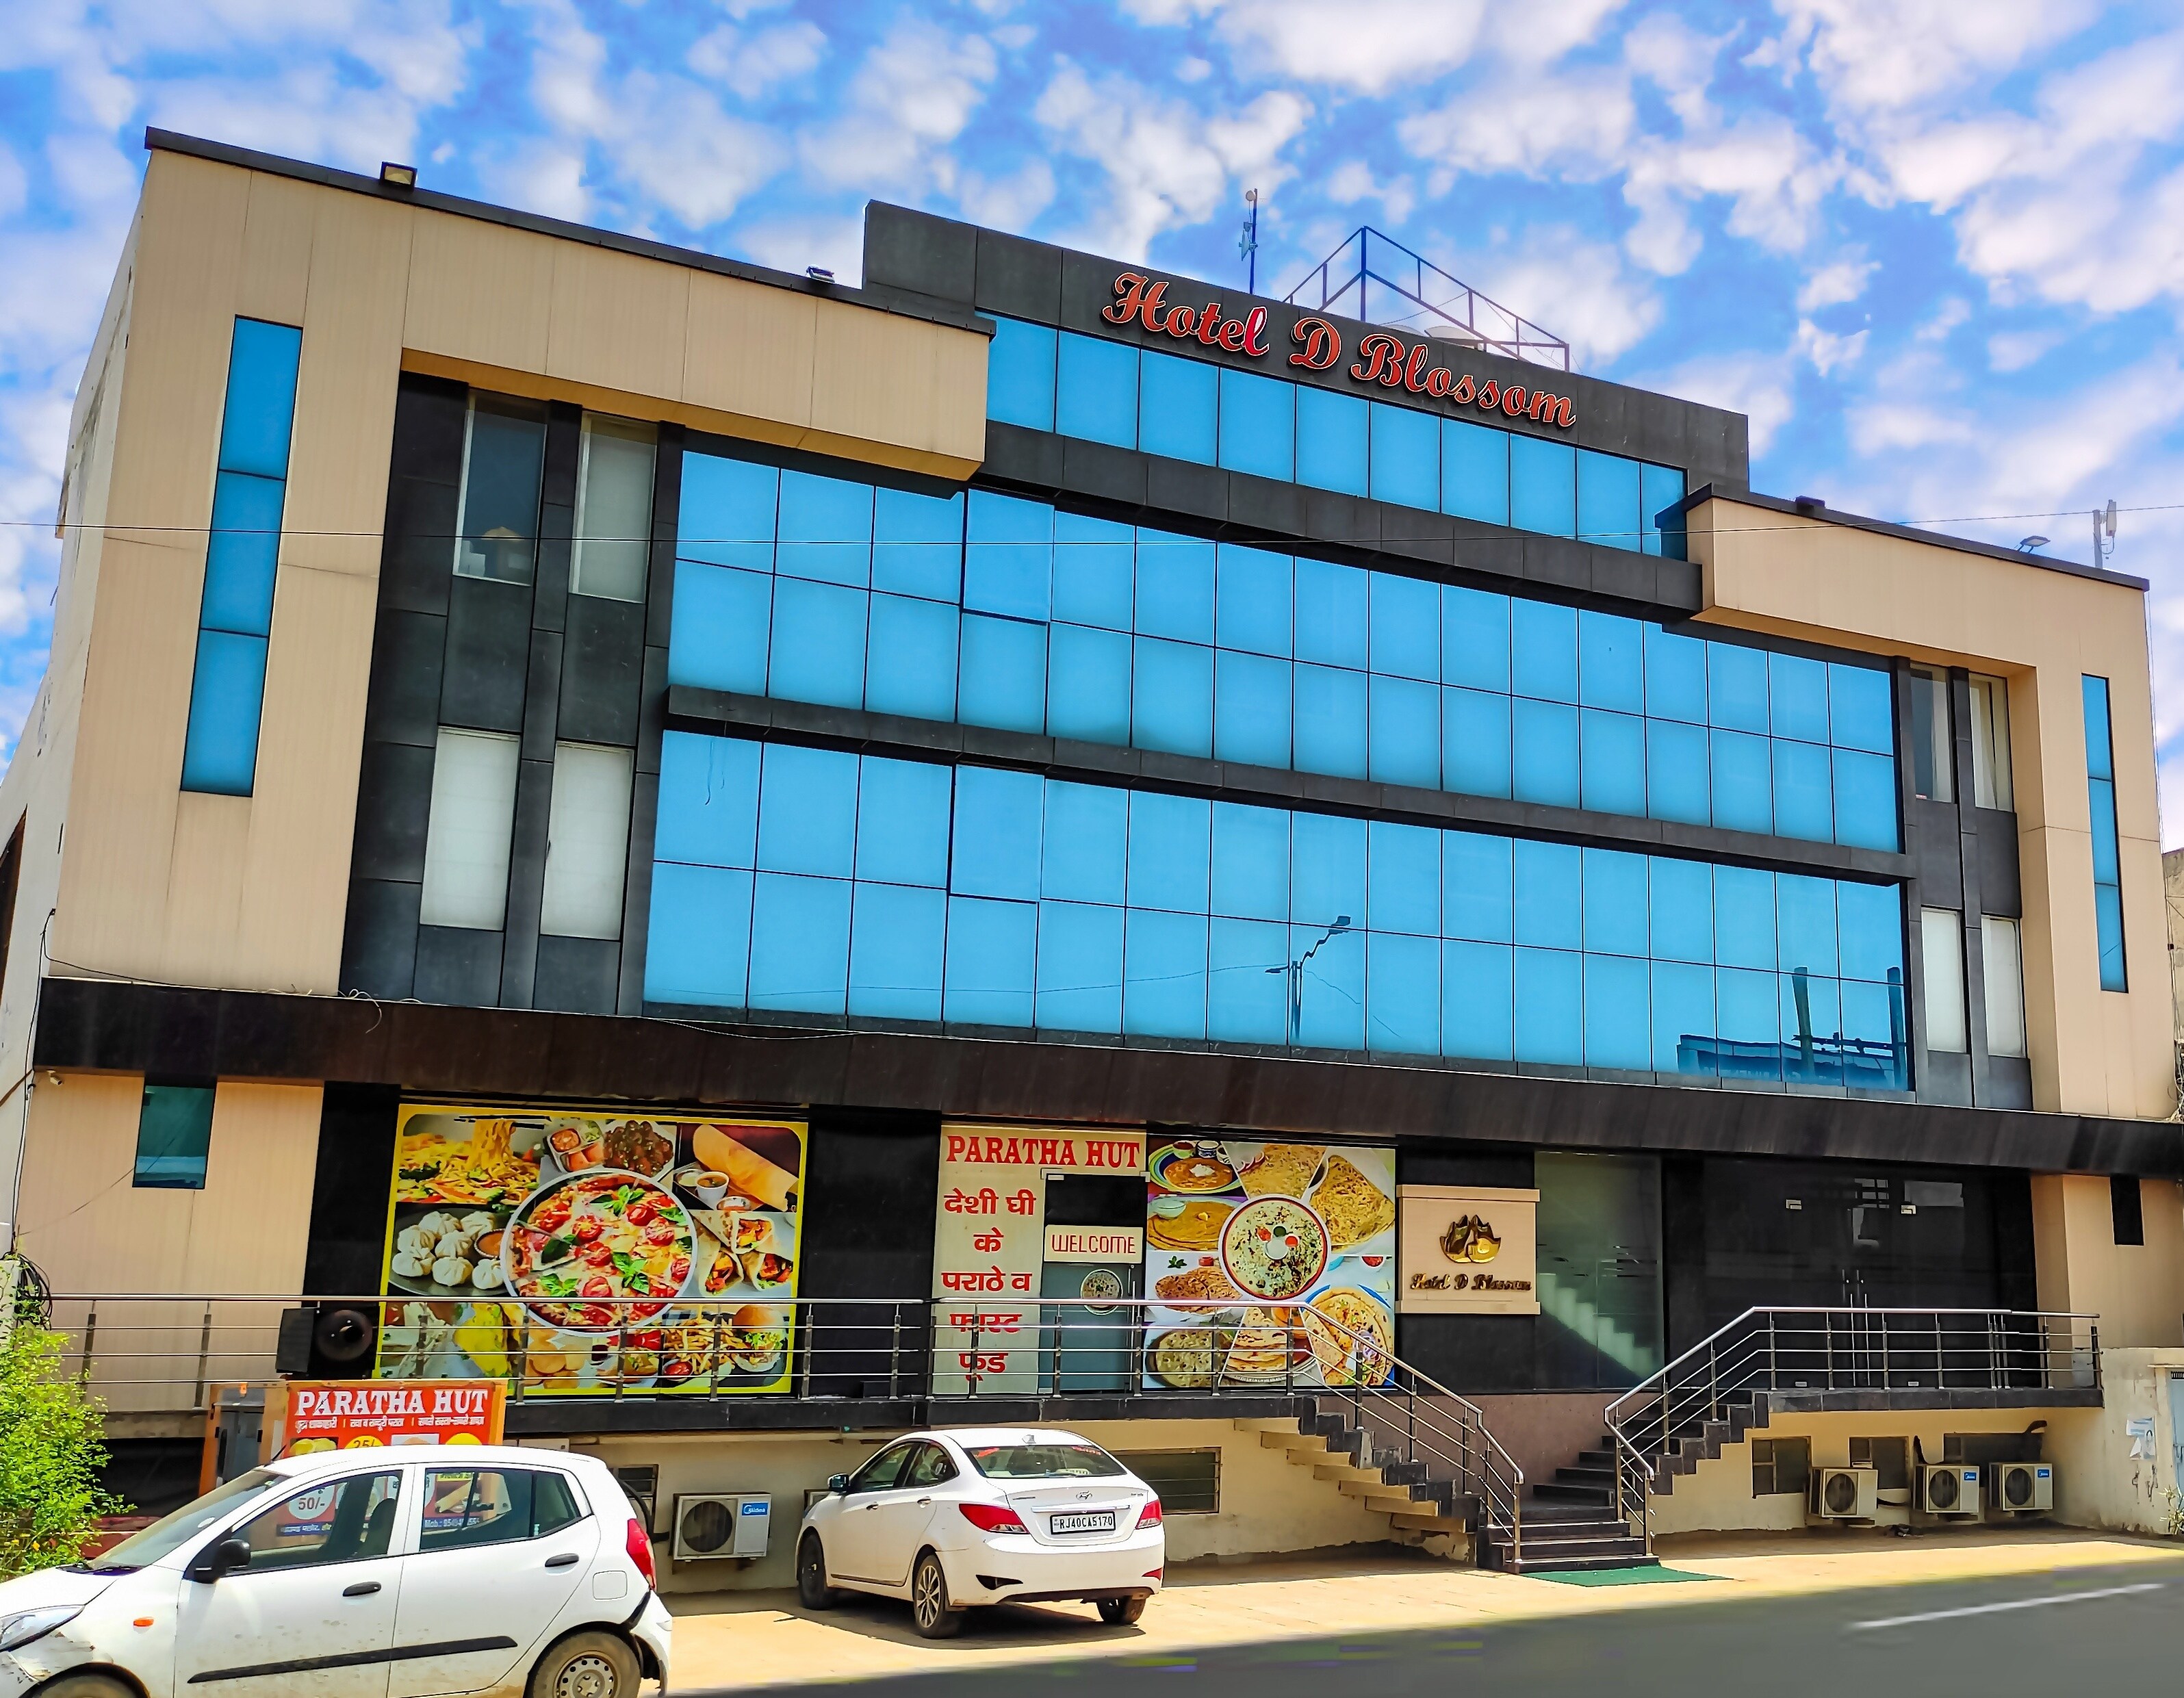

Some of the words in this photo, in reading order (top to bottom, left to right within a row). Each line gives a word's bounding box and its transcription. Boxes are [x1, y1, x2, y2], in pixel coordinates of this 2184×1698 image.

[1101, 272, 1271, 357] Hotel
[1288, 316, 1342, 370] D
[1350, 333, 1577, 428] Blossom
[946, 1135, 1077, 1166] PARATHA
[1085, 1140, 1140, 1168] HUT
[943, 1187, 999, 1215] देशी
[1005, 1189, 1037, 1215] घी
[973, 1227, 1004, 1252] के
[1051, 1234, 1136, 1254] WELCOME
[941, 1265, 1006, 1292] पराठे
[1011, 1272, 1033, 1292] व
[294, 1389, 426, 1416] PARATHA
[433, 1389, 488, 1414] HUT
[298, 1496, 325, 1510] 50/-
[1059, 1515, 1113, 1530] RJ40CA5170
